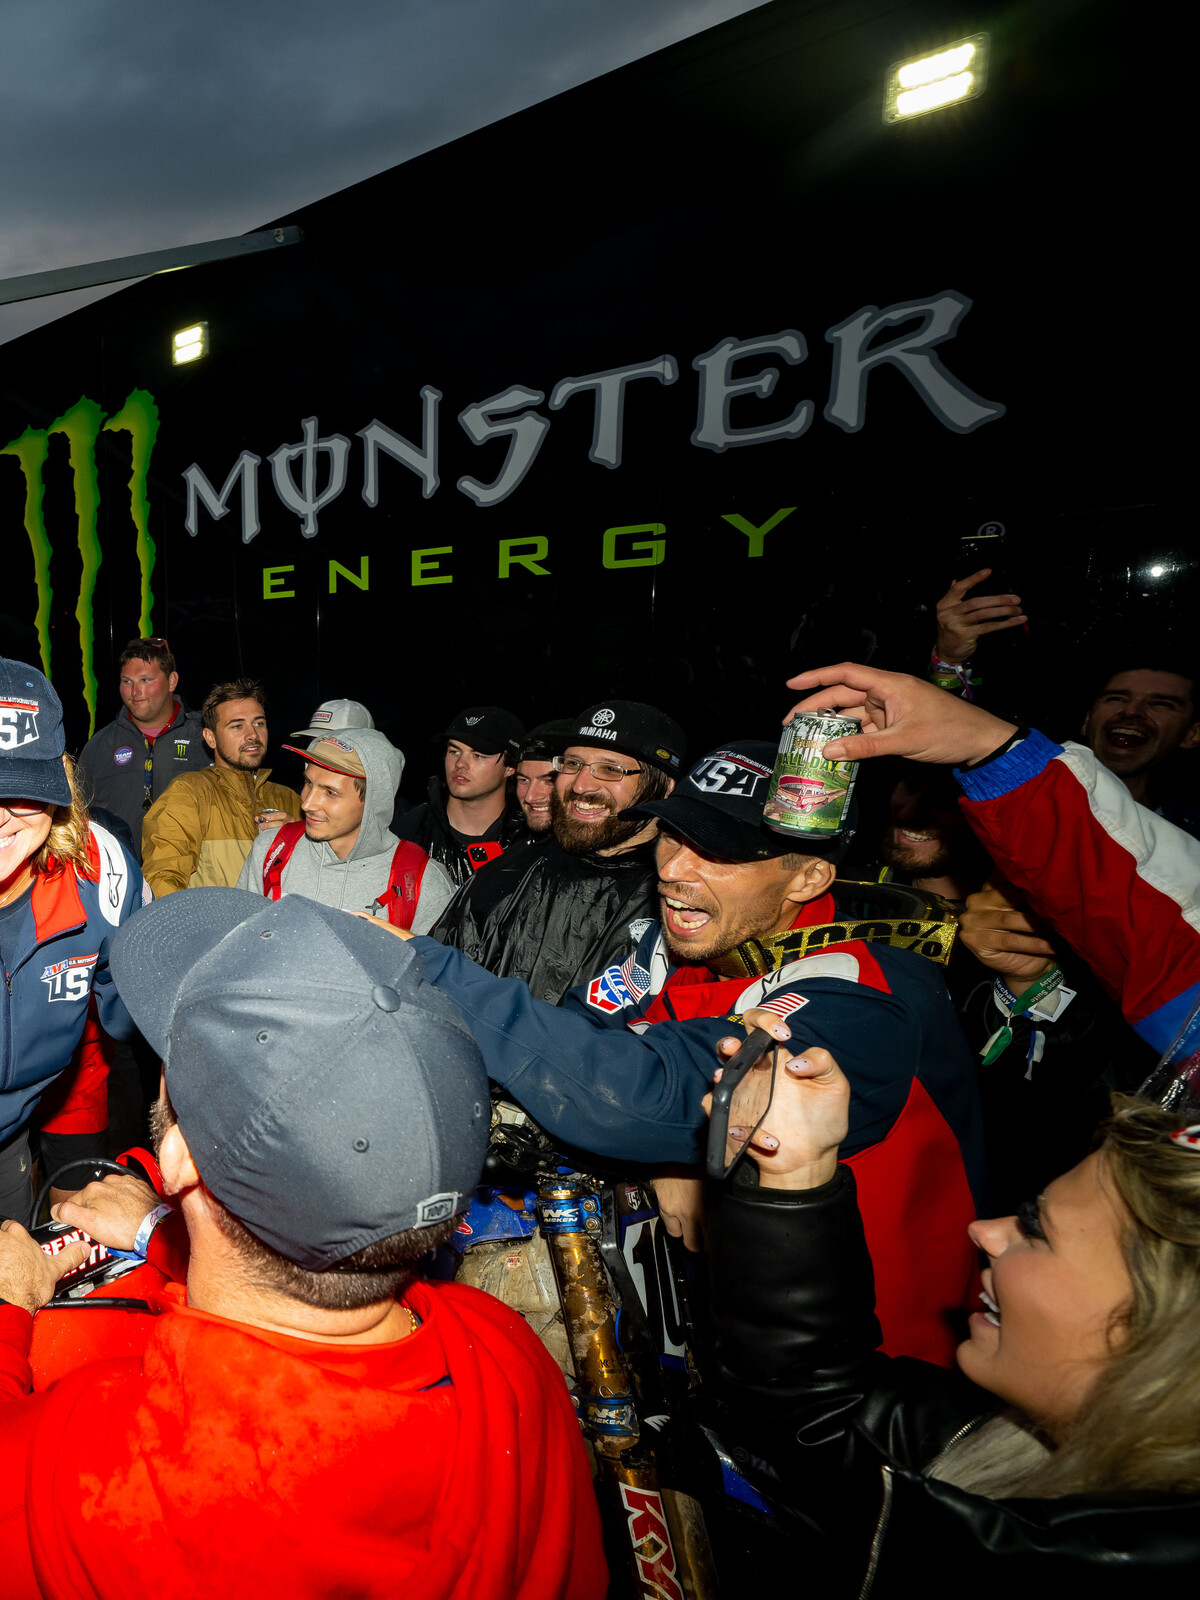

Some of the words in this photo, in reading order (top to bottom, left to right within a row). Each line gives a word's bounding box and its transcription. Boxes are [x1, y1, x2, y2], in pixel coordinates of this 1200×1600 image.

[182, 288, 1008, 544] MONSTER
[262, 506, 799, 600] ENERGY
[578, 725, 618, 742] YAMAHA
[782, 751, 805, 768] ALL
[809, 755, 843, 774] DAY
[995, 977, 1017, 1003] Mechan
[40, 1229, 92, 1256] RENT
[619, 1481, 686, 1600] KY
